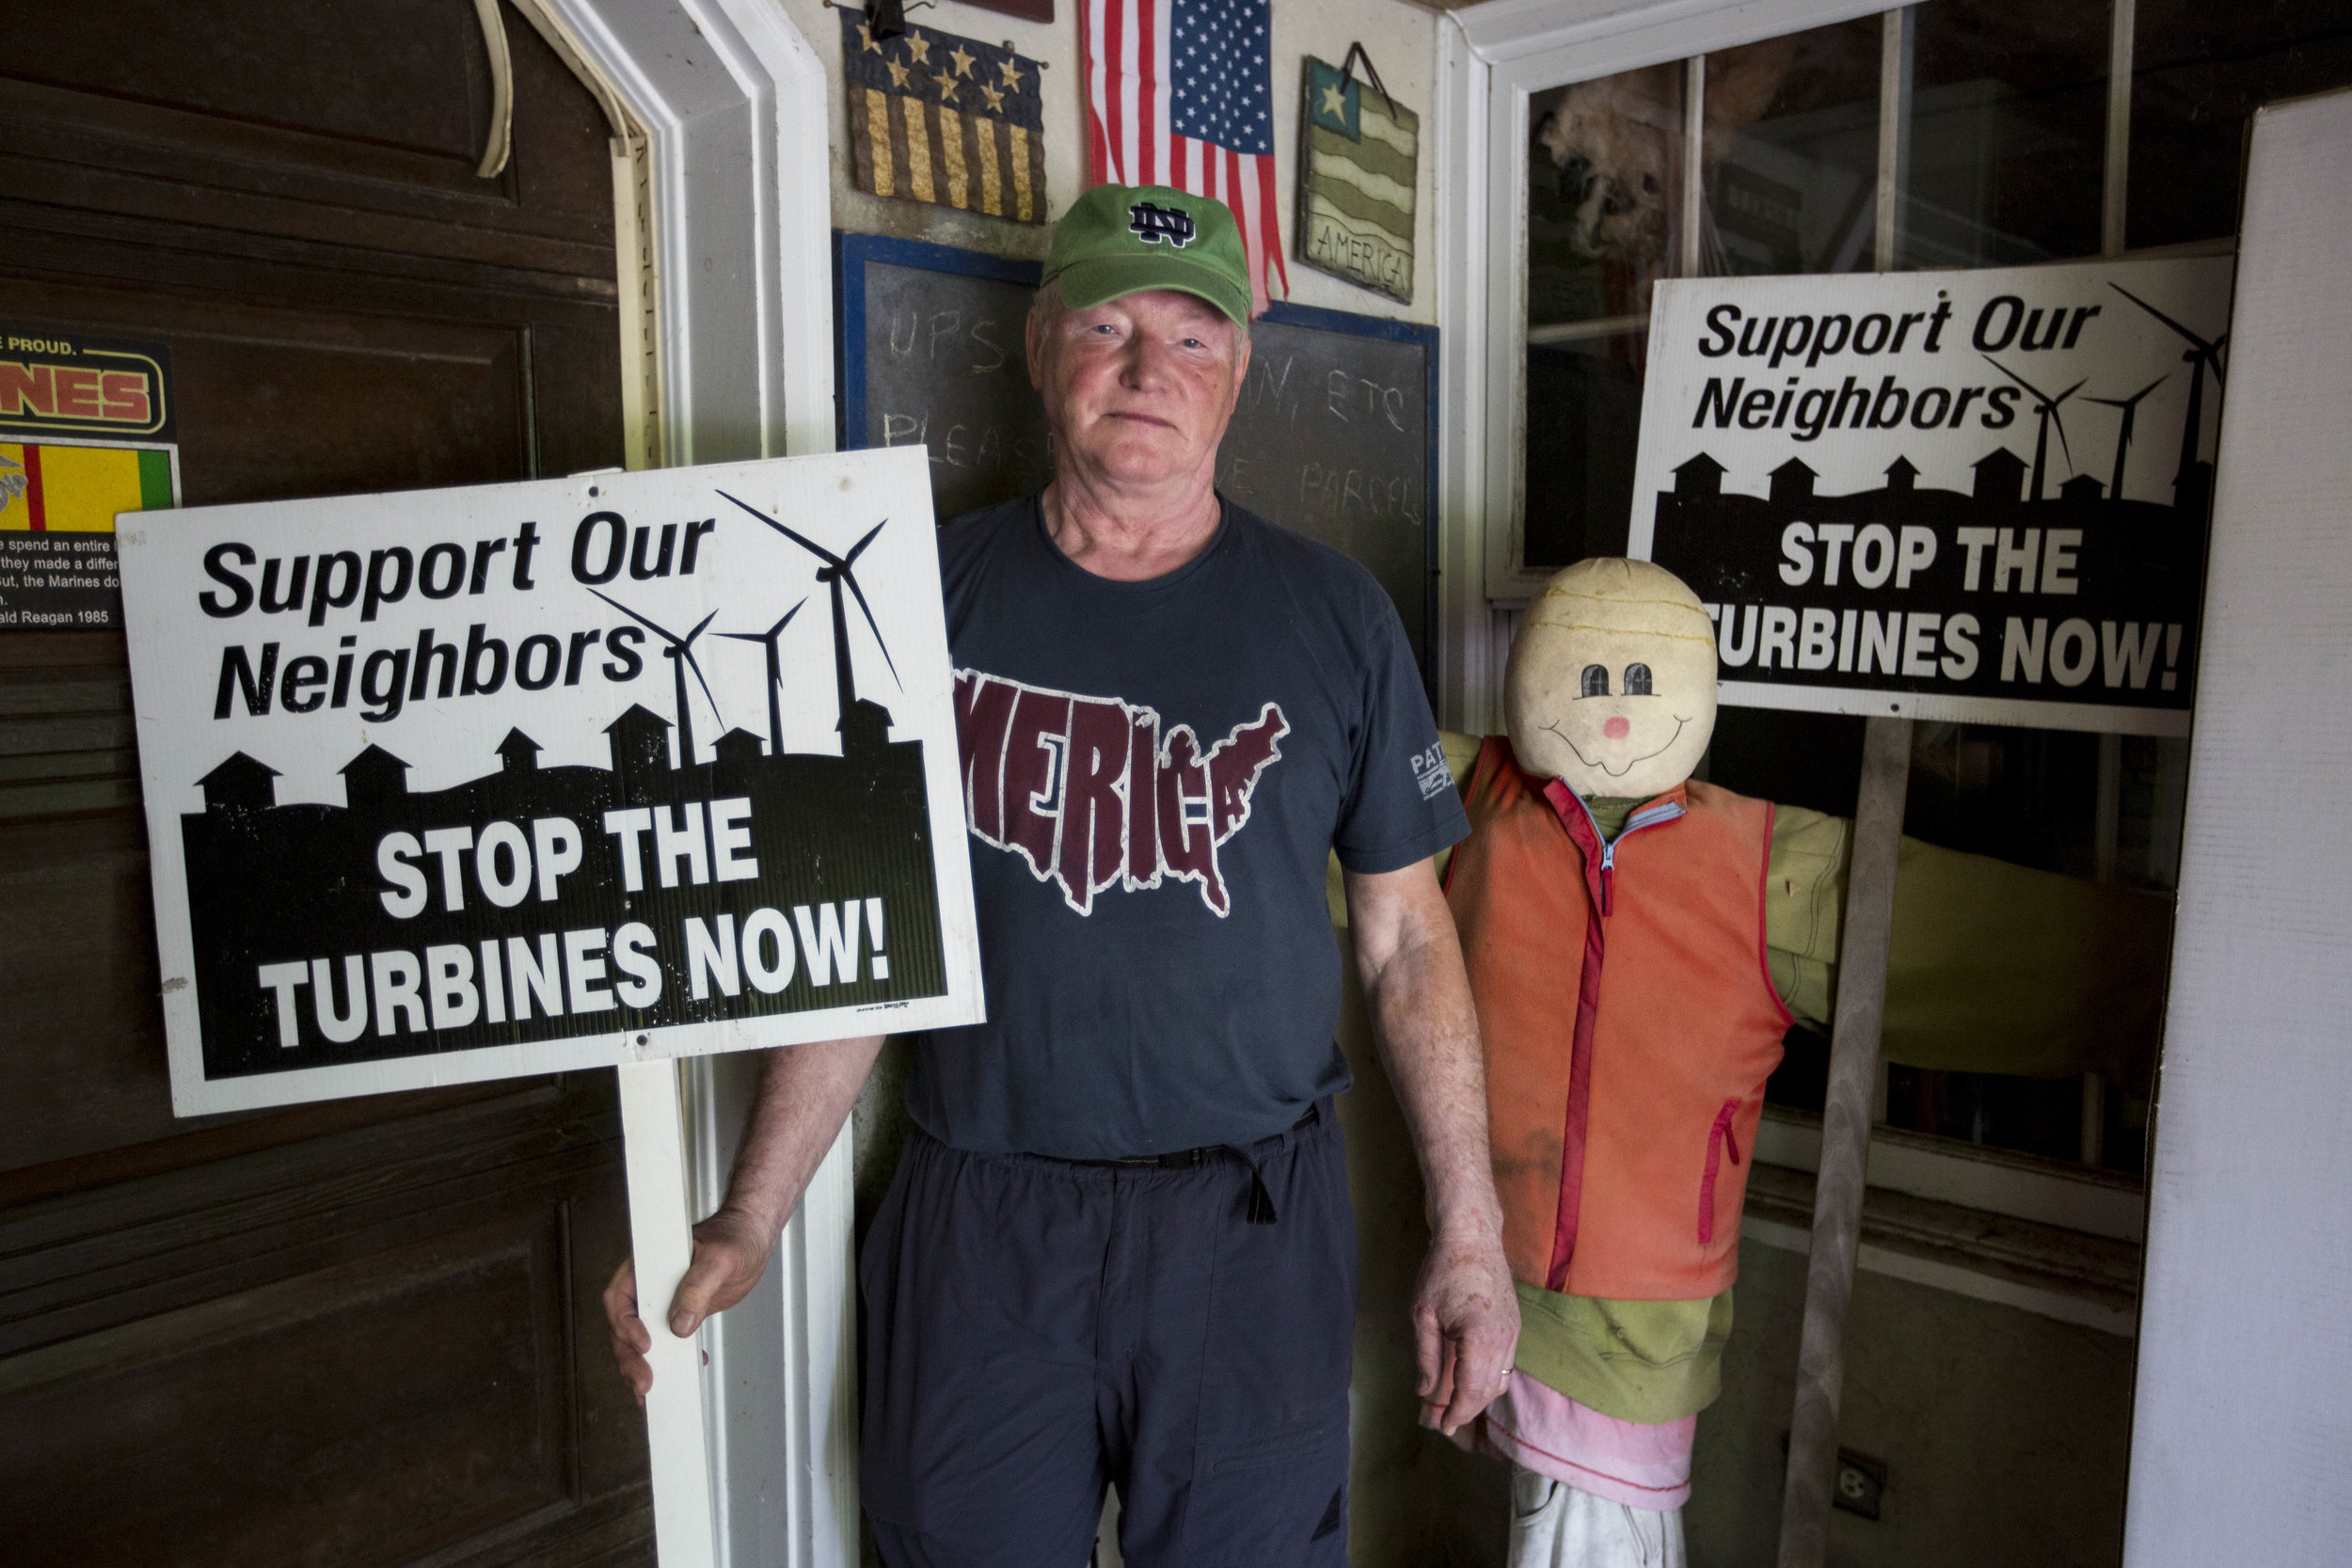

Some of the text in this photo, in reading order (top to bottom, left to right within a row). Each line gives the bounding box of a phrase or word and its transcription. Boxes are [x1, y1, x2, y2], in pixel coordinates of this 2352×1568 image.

[1318, 226, 1406, 291] AMERICA
[8, 336, 77, 356] PROUD.
[890, 311, 1004, 374] UPS
[1699, 296, 2103, 367] Support Our
[1692, 376, 2022, 442] Neighbors
[1, 556, 30, 572] they
[34, 558, 71, 570] made
[74, 560, 83, 570] a
[8, 539, 50, 553] spend
[54, 543, 71, 552] an
[73, 539, 111, 552] entire
[199, 512, 716, 626] Support Our
[1778, 521, 2083, 594] STOP THE
[24, 574, 45, 588] the
[49, 575, 101, 588] Marines
[22, 610, 73, 626] Reagan
[77, 610, 109, 624] 1985
[214, 623, 645, 722] Neighbors
[2001, 617, 2184, 690] NOW!
[378, 798, 759, 919] STOP THE
[260, 897, 889, 1048] TURBINES NOW!
